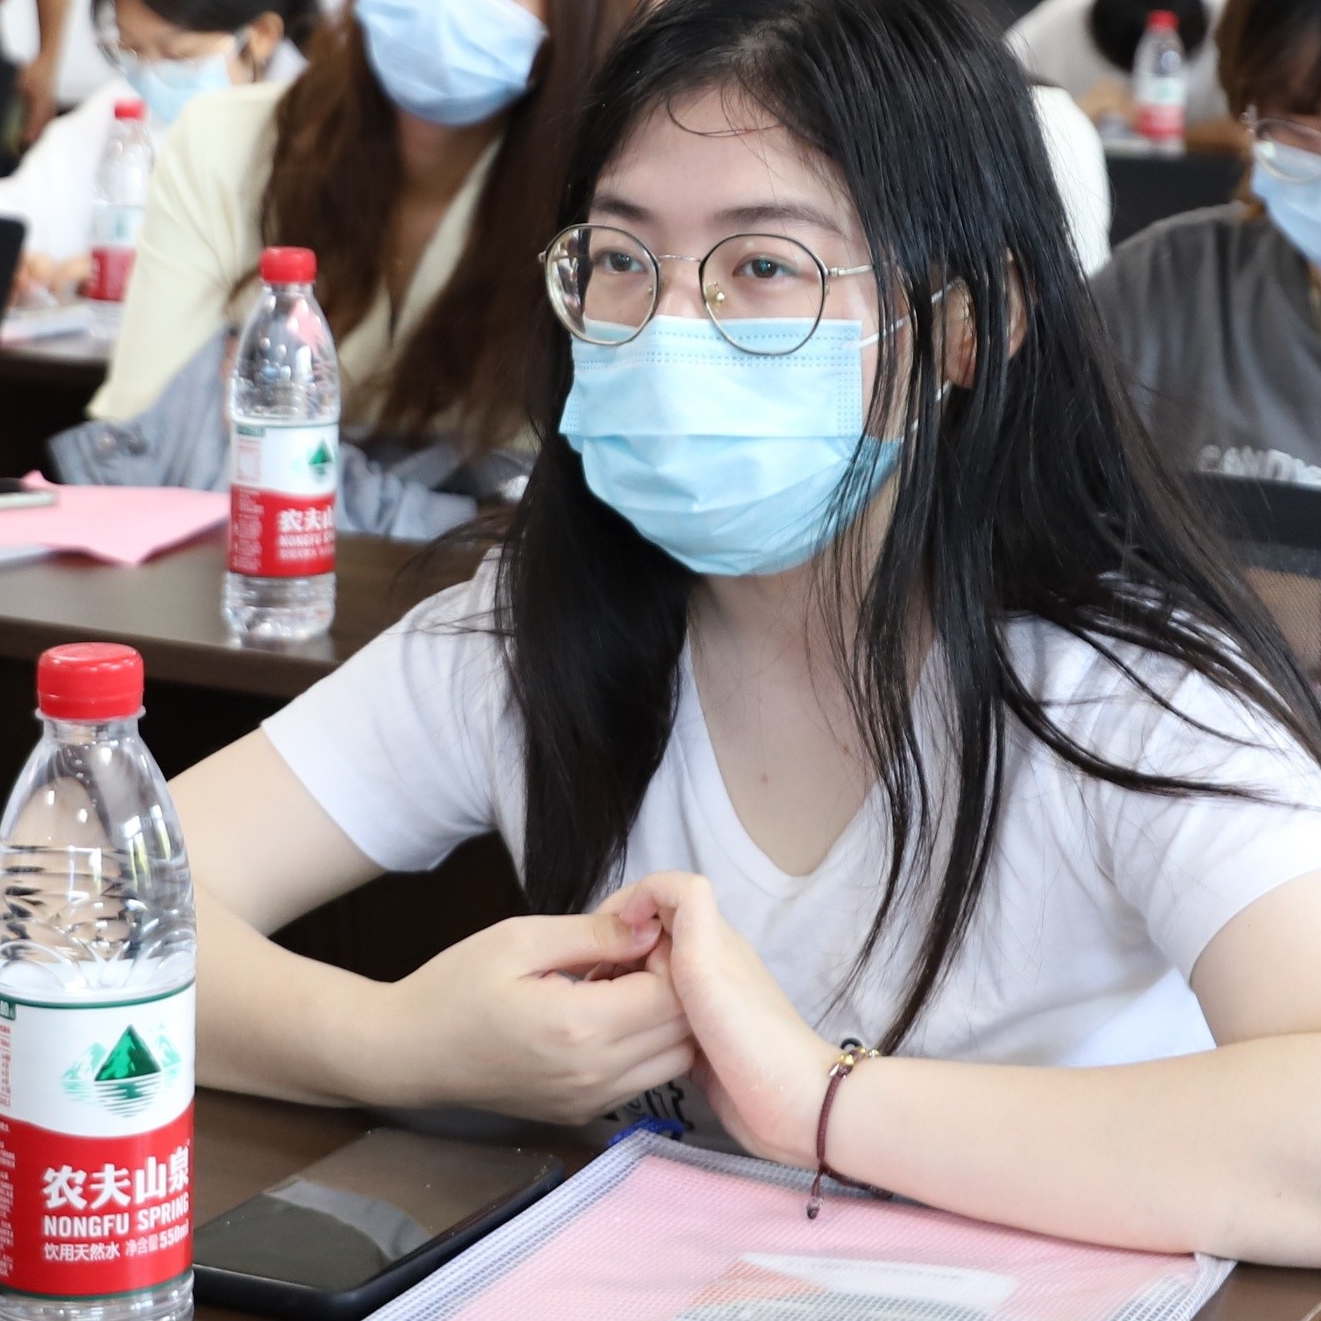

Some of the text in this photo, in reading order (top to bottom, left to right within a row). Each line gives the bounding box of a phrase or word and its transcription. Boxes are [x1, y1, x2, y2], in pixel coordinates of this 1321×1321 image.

[42, 1145, 190, 1210] 农夫山泉
[43, 1191, 190, 1238] NONGFU SPRING
[43, 1241, 121, 1262] 饮用天然水
